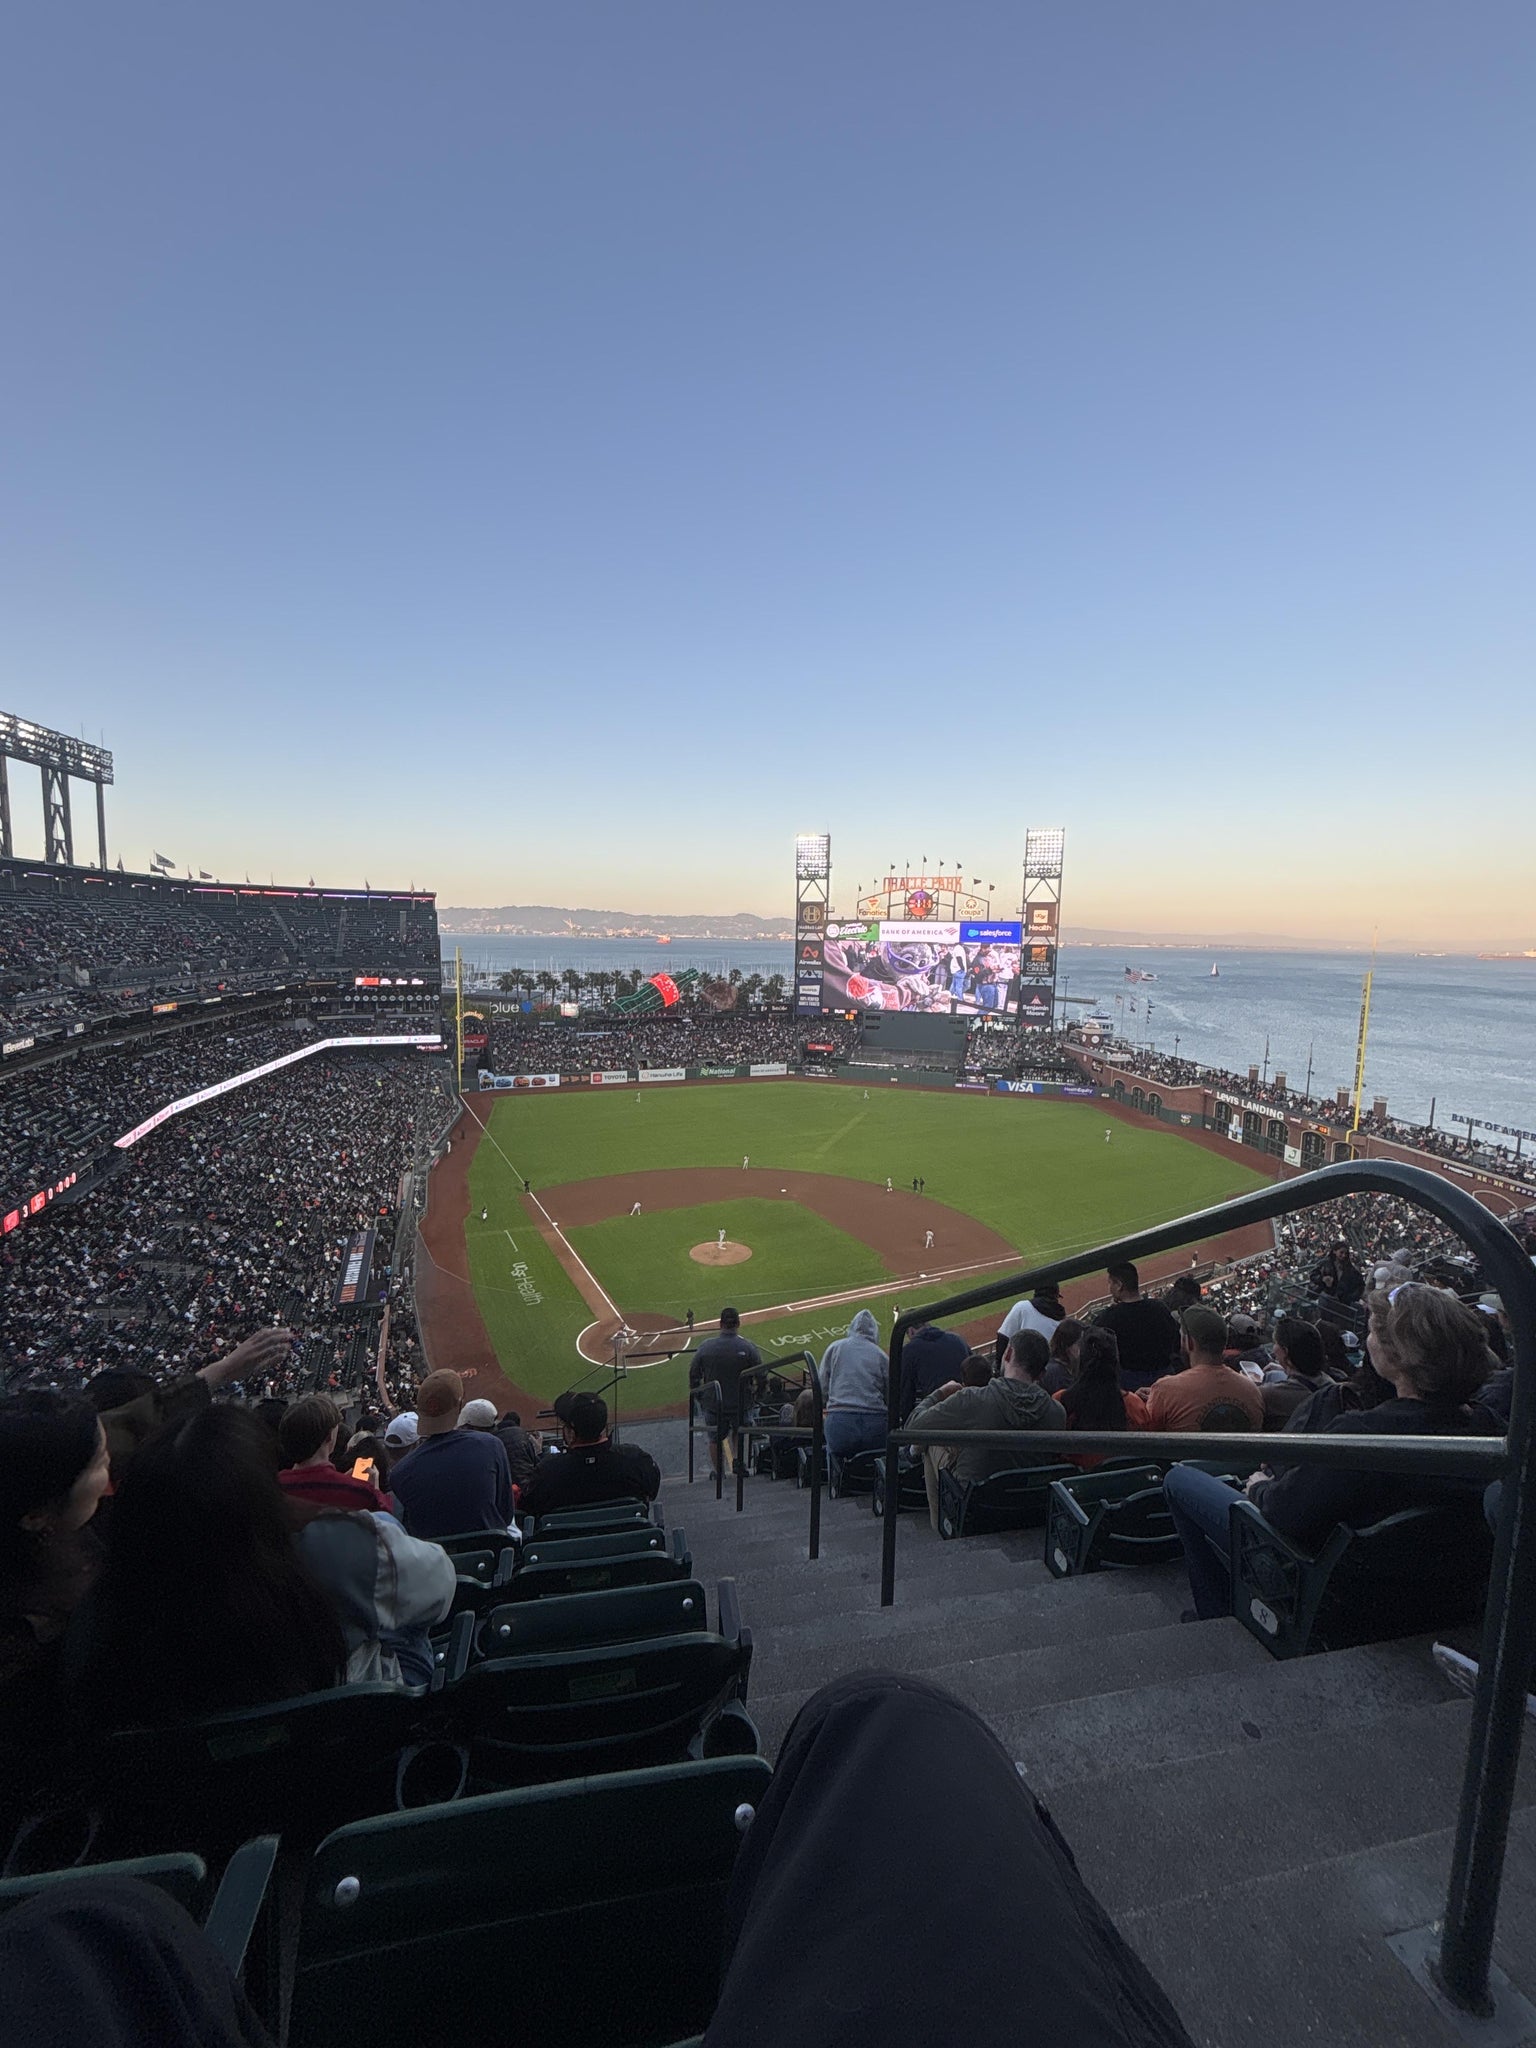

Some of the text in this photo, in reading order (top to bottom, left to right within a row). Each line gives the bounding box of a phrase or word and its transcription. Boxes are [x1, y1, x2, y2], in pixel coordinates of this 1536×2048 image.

[884, 877, 962, 893] ORACLE PARK
[859, 908, 887, 917] Fanatics
[979, 929, 1012, 938] salesforce
[489, 1001, 520, 1014] blue
[708, 1067, 736, 1076] National
[1007, 1081, 1034, 1093] VISA
[1241, 1099, 1285, 1120] LANDING
[1452, 1113, 1483, 1127] BANK
[1484, 1122, 1500, 1132] OF
[22, 1205, 29, 1218] 3
[48, 1187, 53, 1200] 0
[515, 1276, 544, 1306] Health
[770, 1333, 812, 1346] UCSF
